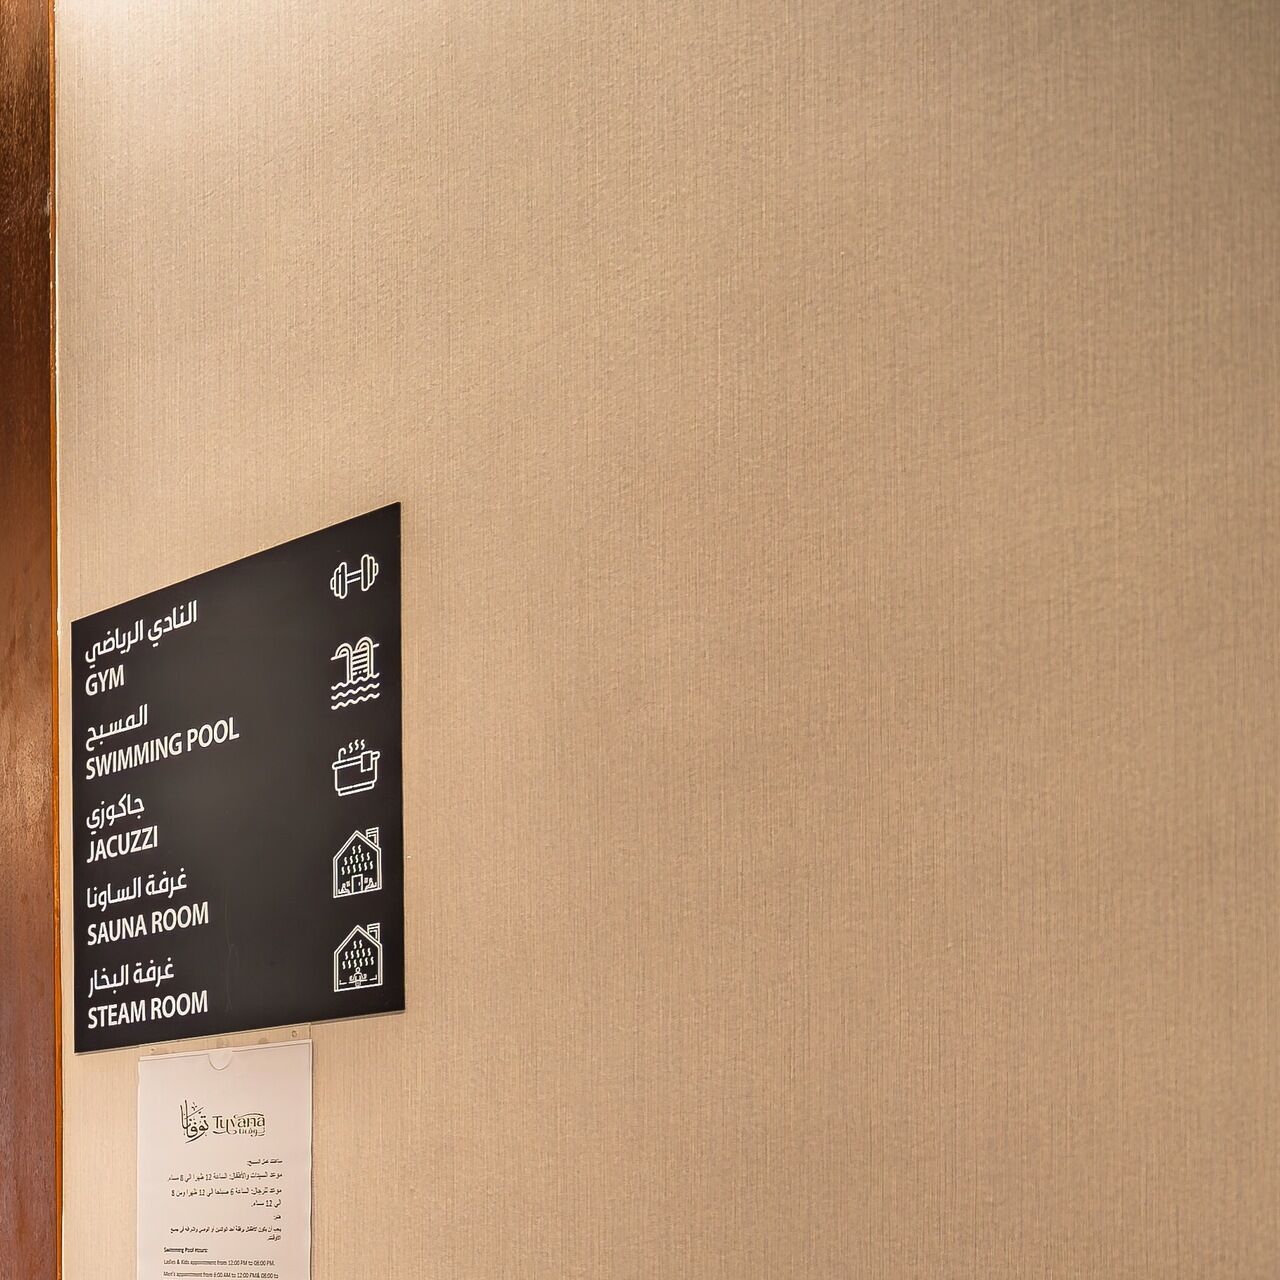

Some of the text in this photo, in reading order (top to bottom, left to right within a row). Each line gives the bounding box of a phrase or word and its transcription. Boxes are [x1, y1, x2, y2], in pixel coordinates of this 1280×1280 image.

[85, 600, 198, 663] النادي الرياضي
[85, 664, 125, 696] GYM
[85, 704, 148, 751] المسبح
[86, 717, 239, 780] SWIMMING POOL
[85, 794, 144, 831] جاكوزي
[87, 826, 158, 863] JACUZZI
[86, 870, 187, 910] غرفة الساونا
[87, 901, 208, 945] SAUNA ROOM
[88, 963, 174, 998] غرفة البخار
[88, 990, 208, 1029] STEAM ROOM
